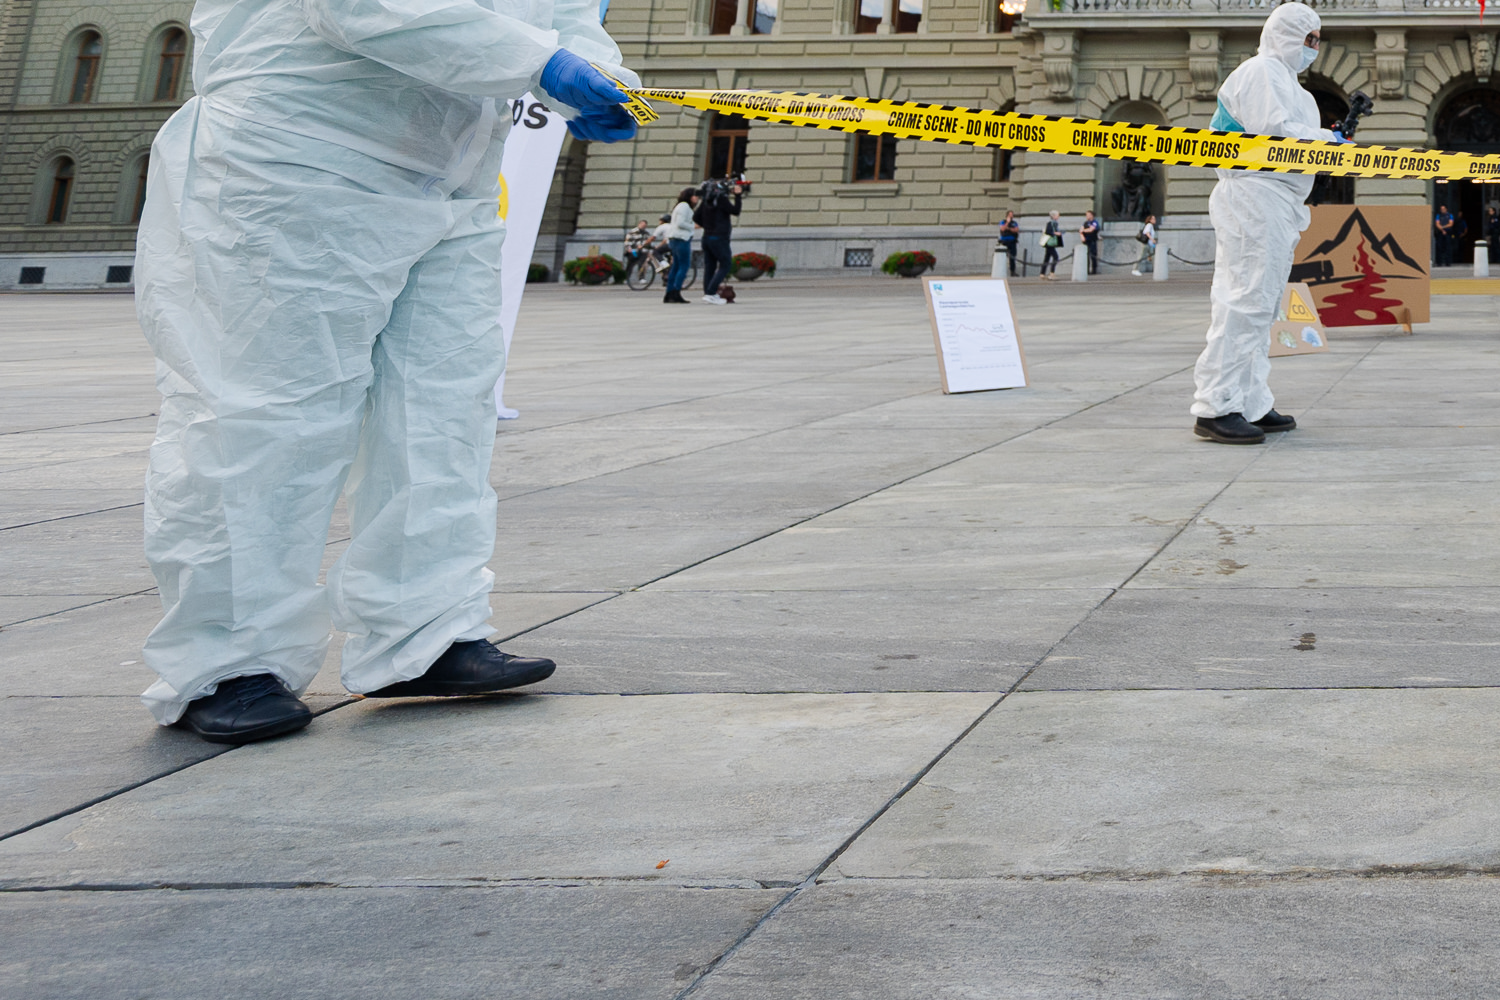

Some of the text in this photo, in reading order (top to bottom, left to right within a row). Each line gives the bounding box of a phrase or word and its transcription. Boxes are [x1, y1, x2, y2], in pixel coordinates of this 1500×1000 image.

[632, 104, 652, 122] NOT
[709, 92, 746, 108] CRIME
[745, 96, 782, 112] SCENE
[787, 100, 804, 115] DO
[804, 103, 829, 119] NOT
[827, 106, 866, 122] CROSS
[887, 111, 923, 130] CRIME
[924, 115, 958, 134] SCENE
[966, 119, 982, 136] DO
[984, 121, 1006, 138] NOT
[1008, 123, 1046, 142] CROSS
[1072, 129, 1108, 148] CRIME
[1111, 132, 1147, 151] SCENE
[1156, 137, 1172, 154] DO
[1174, 139, 1199, 156] NOT
[1200, 140, 1240, 159] CROSS
[1267, 146, 1306, 164] CRIME
[1307, 150, 1345, 167] SCENE
[1353, 153, 1371, 168] DO
[1372, 154, 1398, 170] NOT
[1400, 156, 1441, 172] CROSS
[1469, 162, 1500, 174] CRIM
